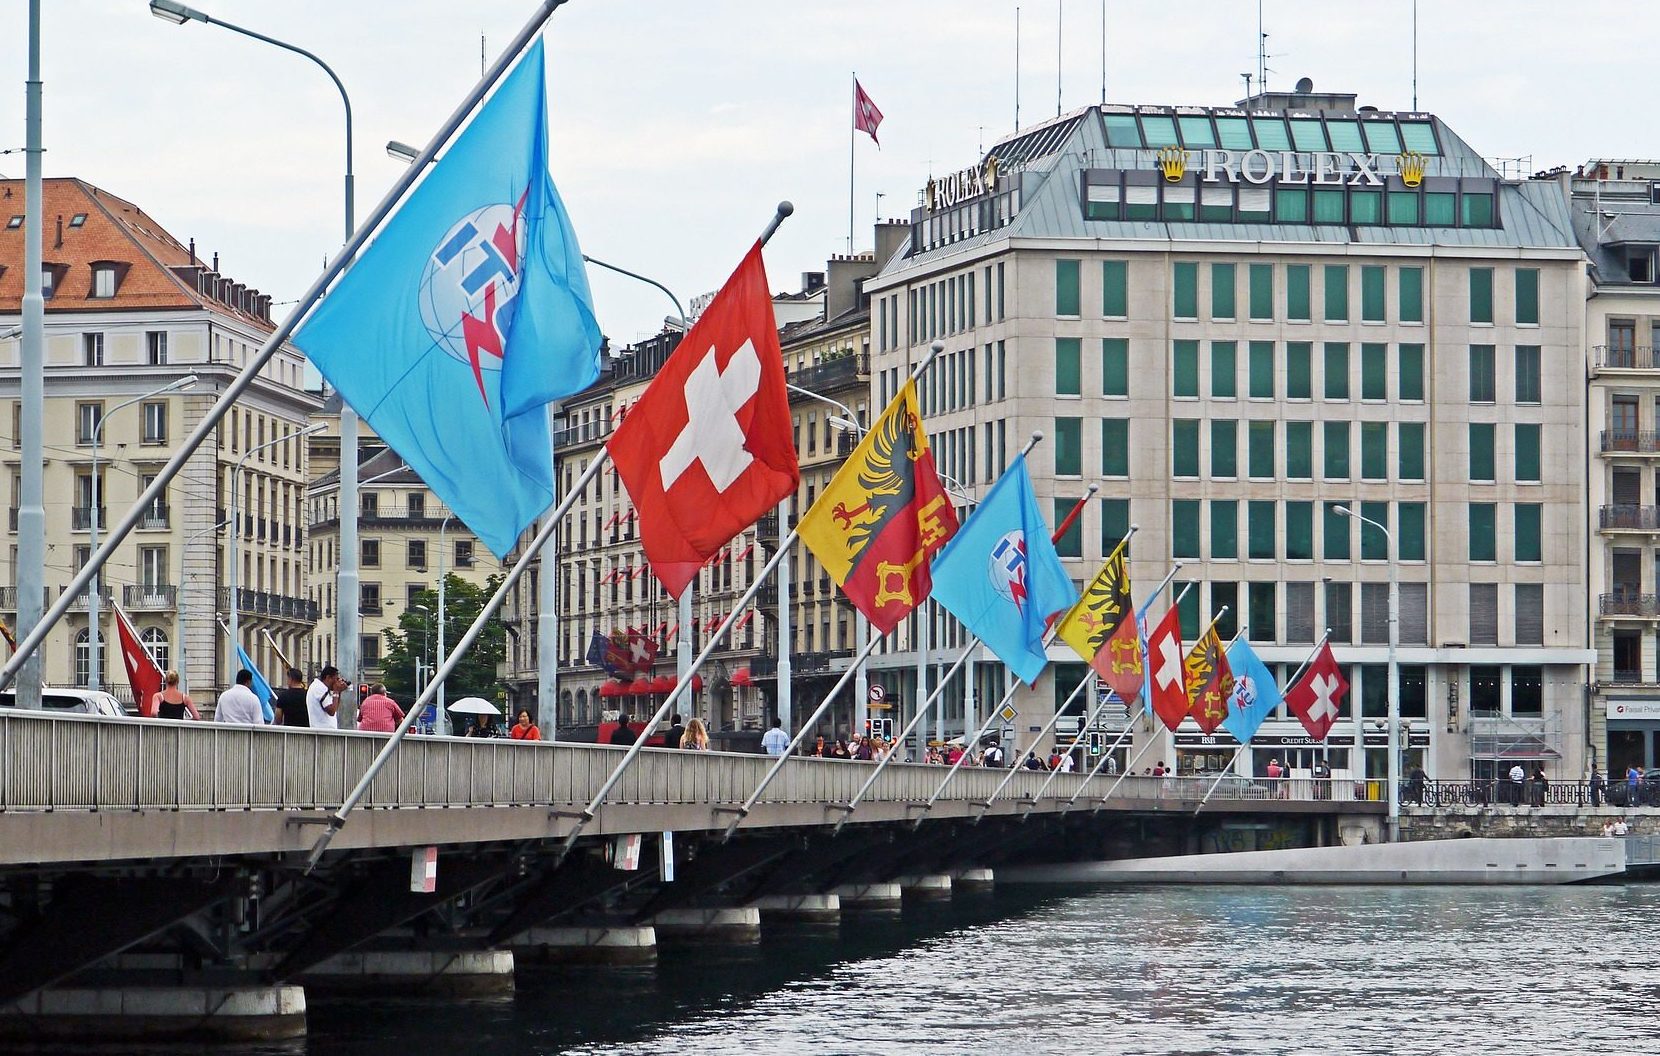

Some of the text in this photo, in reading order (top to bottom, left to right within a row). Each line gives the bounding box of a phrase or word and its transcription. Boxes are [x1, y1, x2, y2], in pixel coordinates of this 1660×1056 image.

[934, 163, 985, 210] ROLEX
[1203, 149, 1384, 186] ROLEX
[992, 538, 1027, 589] IT
[1280, 737, 1304, 745] CREDIT
